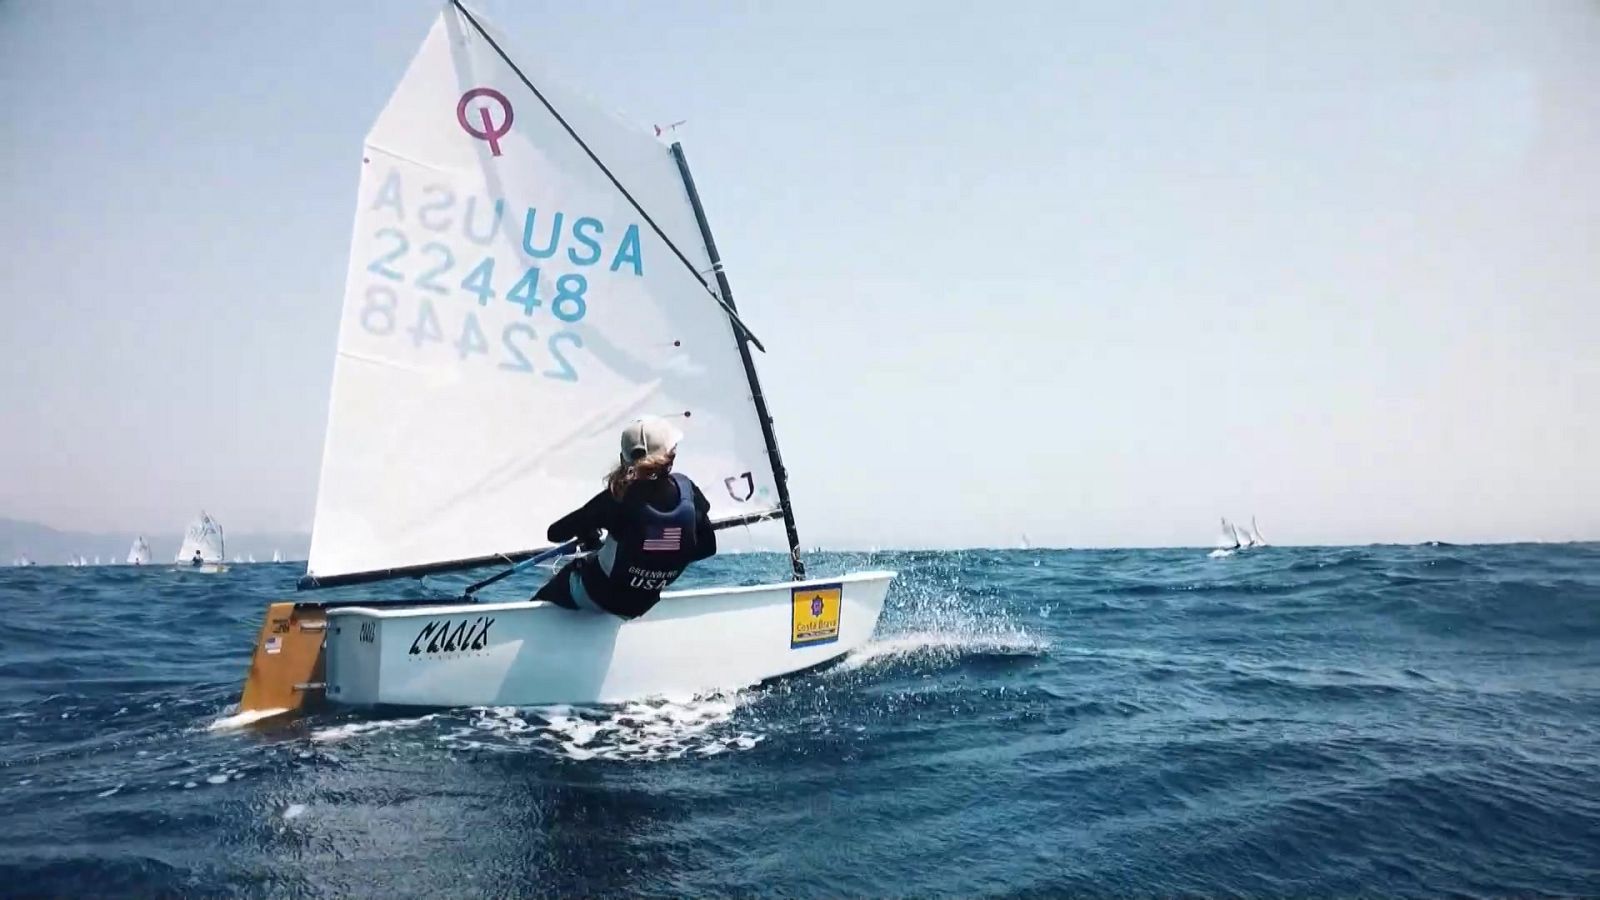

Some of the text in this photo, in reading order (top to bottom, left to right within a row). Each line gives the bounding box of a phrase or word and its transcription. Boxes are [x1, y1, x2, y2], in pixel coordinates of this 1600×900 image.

[367, 228, 588, 322] 22448
[522, 207, 643, 276] USA
[630, 576, 667, 590] USA
